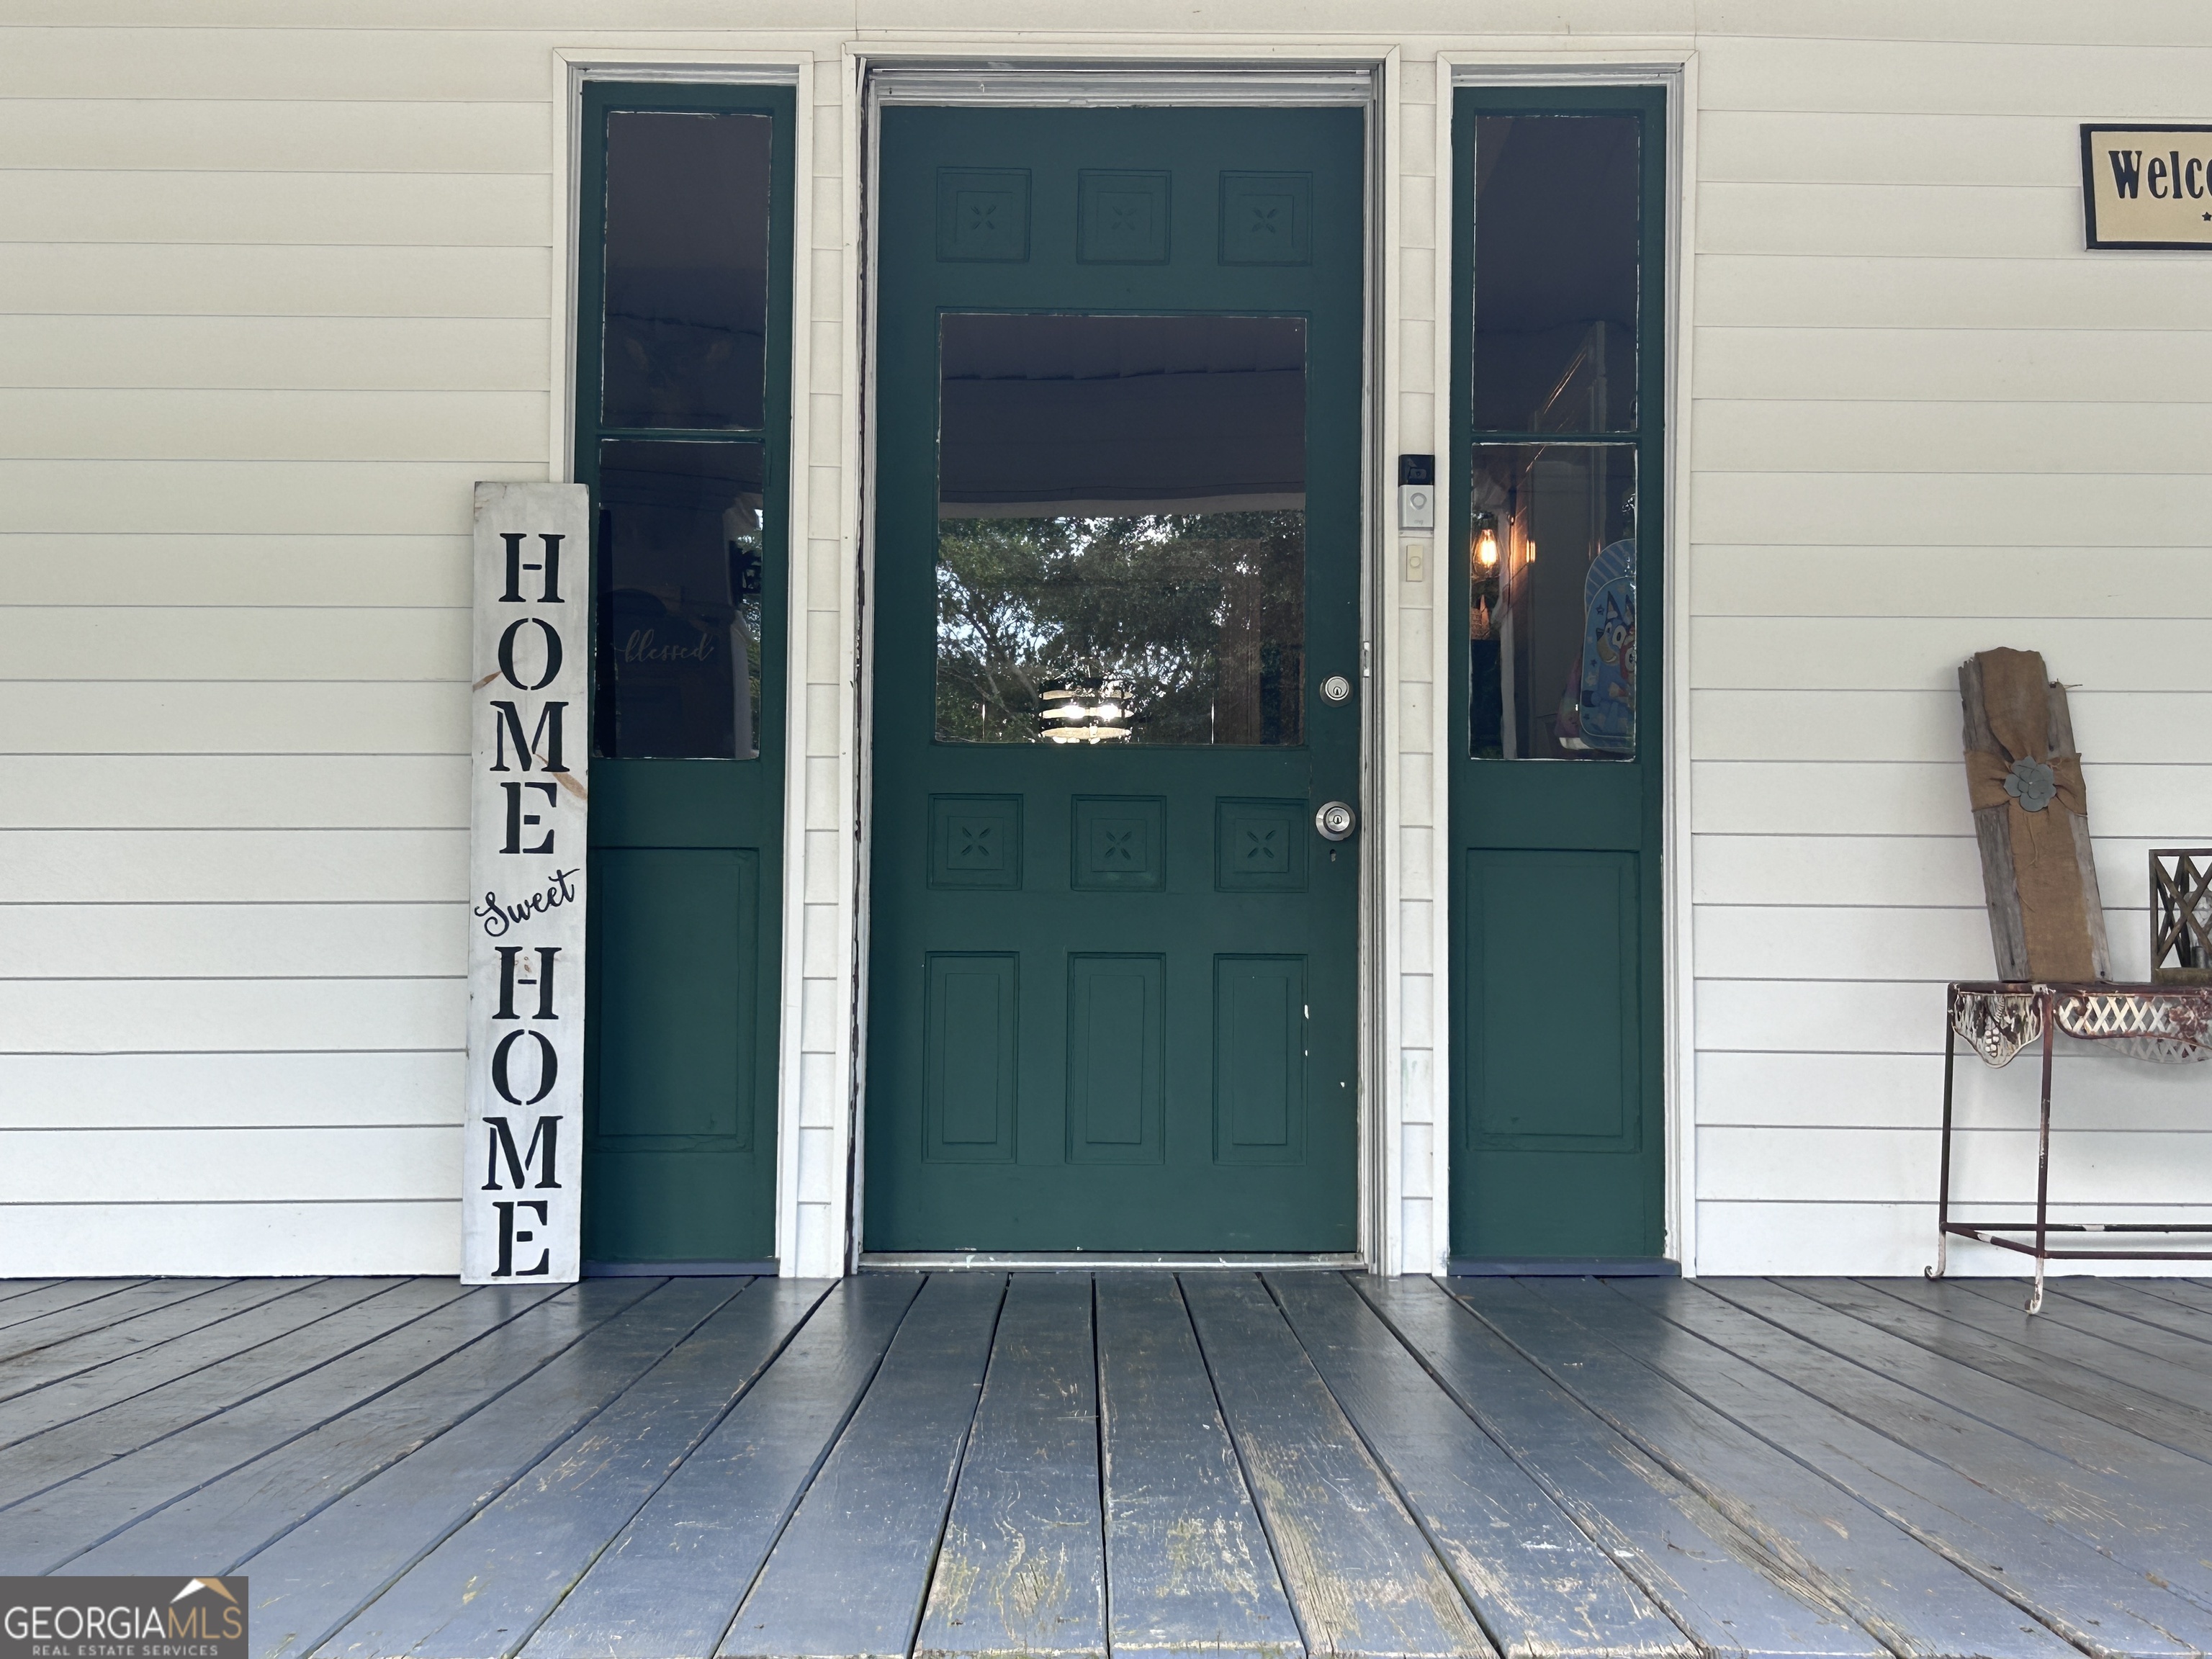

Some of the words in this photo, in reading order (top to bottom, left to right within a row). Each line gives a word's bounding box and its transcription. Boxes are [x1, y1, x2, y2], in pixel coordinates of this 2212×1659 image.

[490, 533, 570, 854] HOME
[611, 628, 715, 663] blessed
[474, 868, 580, 938] Sweet
[481, 946, 564, 1277] HOME
